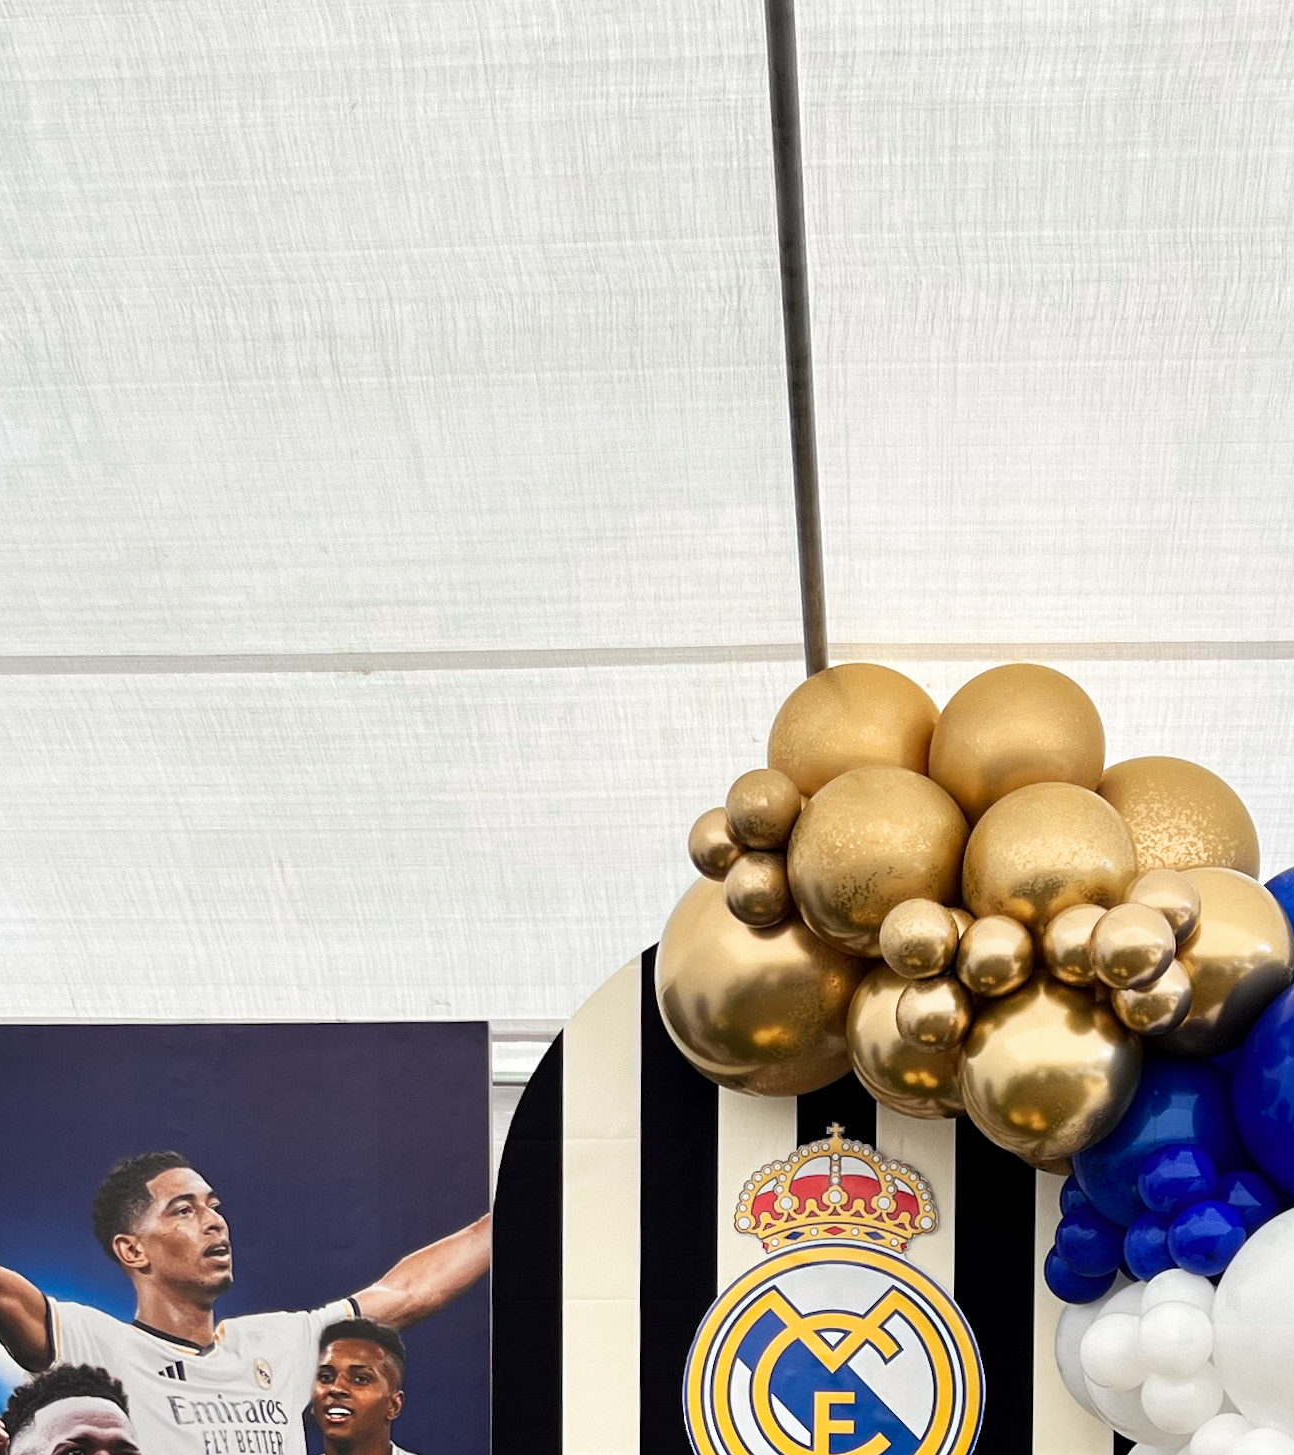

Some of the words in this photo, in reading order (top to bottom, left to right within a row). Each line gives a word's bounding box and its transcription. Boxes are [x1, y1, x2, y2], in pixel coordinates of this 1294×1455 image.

[167, 1394, 288, 1425] Emirates
[203, 1430, 229, 1455] FLY
[235, 1430, 284, 1455] BETTER
